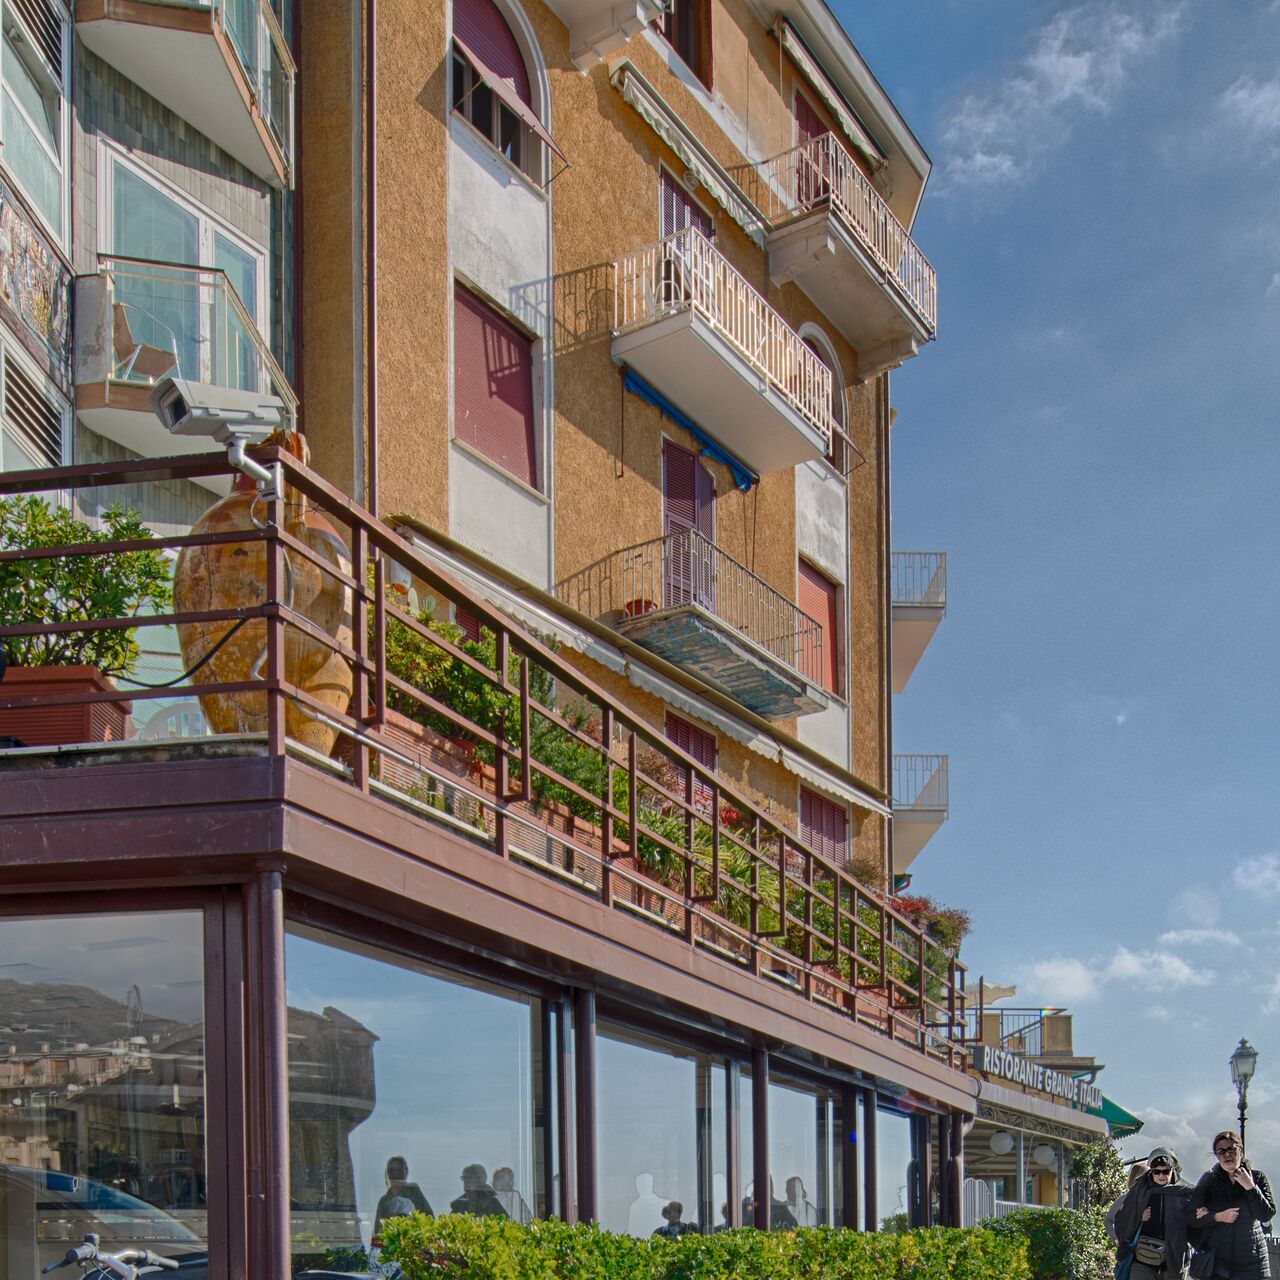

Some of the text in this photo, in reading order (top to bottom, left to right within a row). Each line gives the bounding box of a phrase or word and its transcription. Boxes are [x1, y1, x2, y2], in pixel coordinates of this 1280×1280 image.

[983, 1046, 1103, 1110] RISTORANTE GRANDE ITALIA
